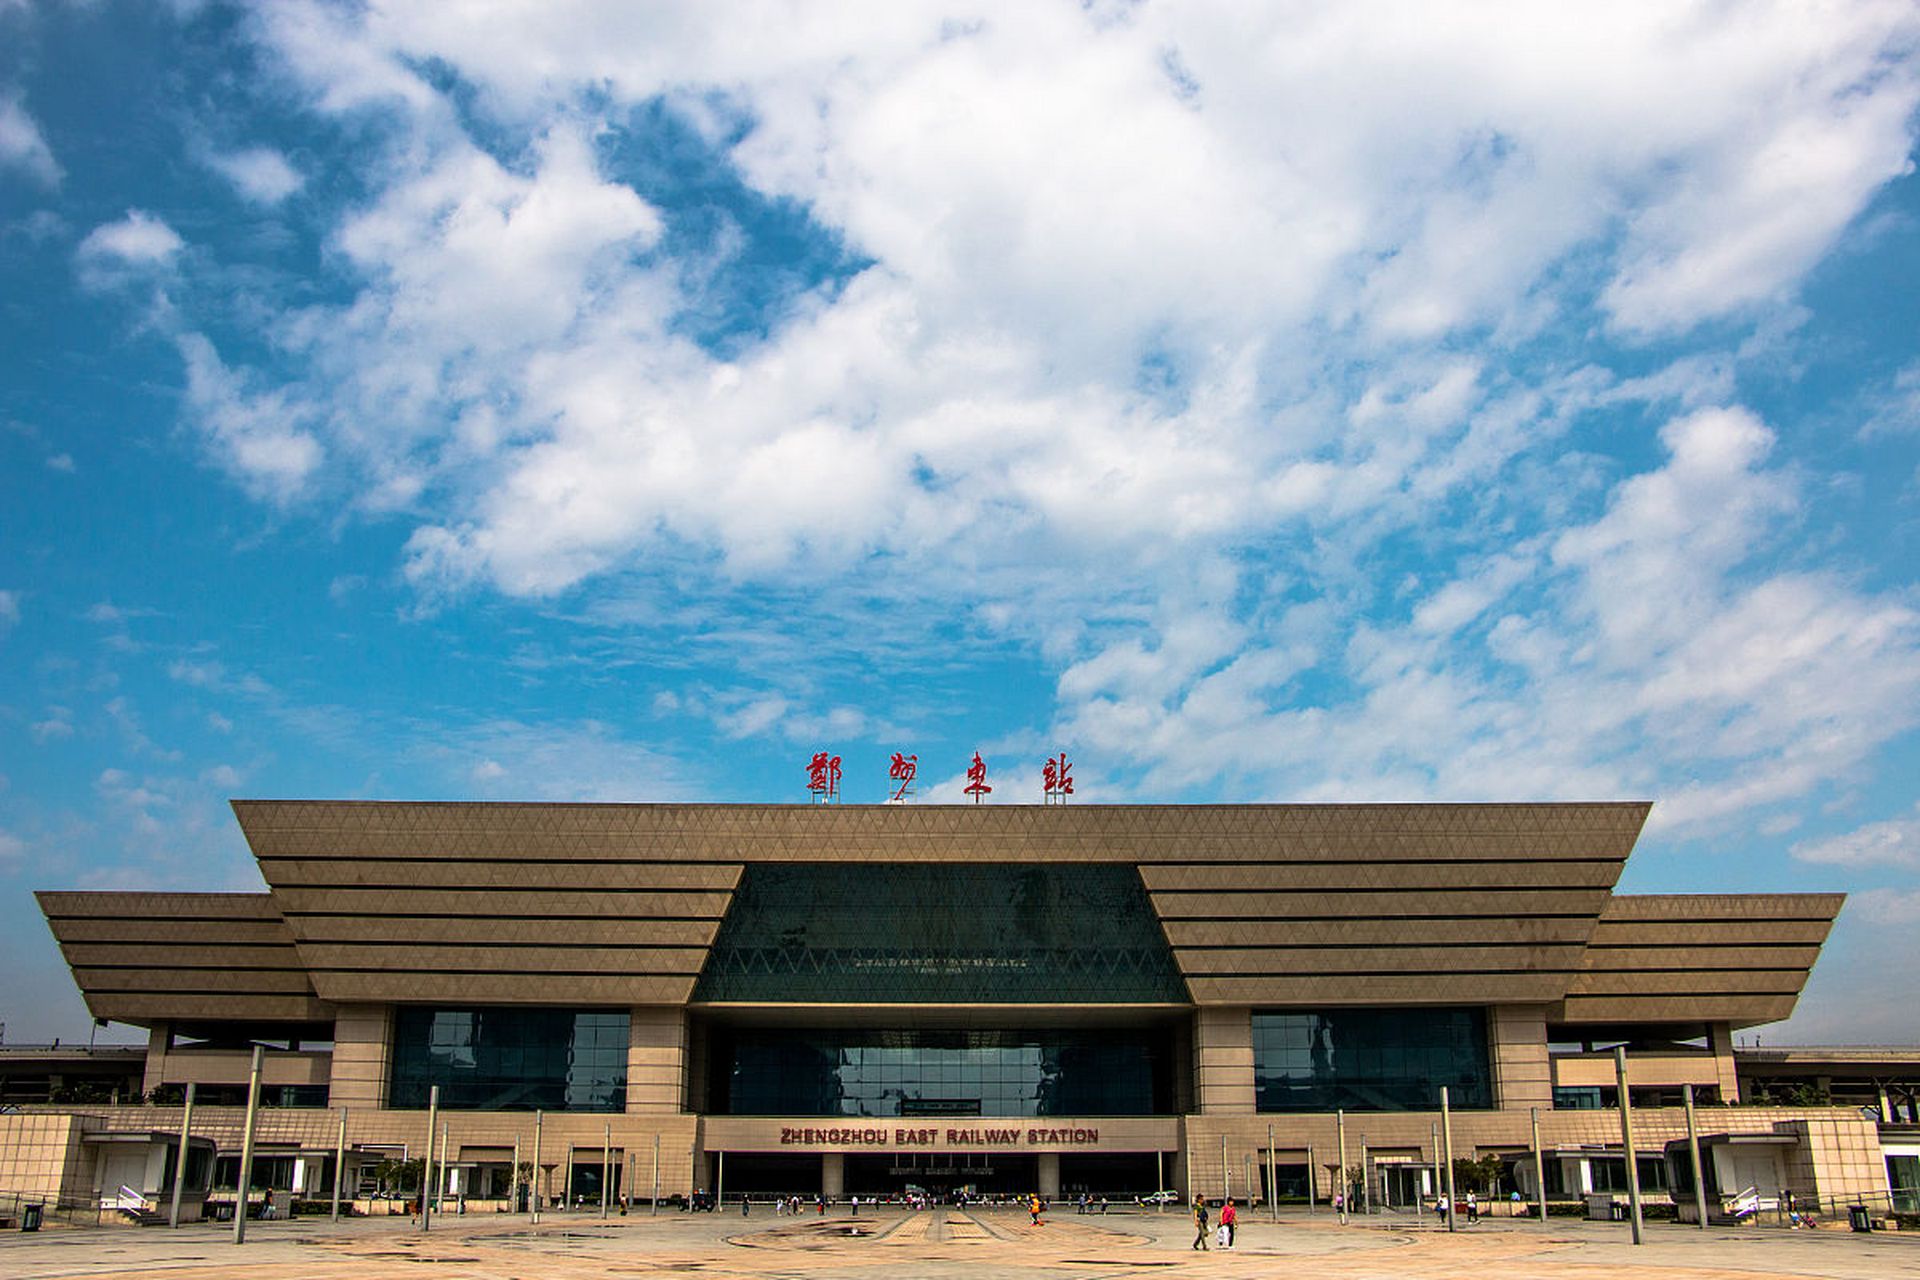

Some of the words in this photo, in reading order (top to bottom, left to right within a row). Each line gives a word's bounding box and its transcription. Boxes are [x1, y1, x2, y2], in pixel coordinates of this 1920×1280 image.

[780, 1128, 887, 1145] ZHENGZHOU
[895, 1128, 938, 1145] EAST
[946, 1128, 1020, 1145] RAILWAY
[1027, 1128, 1099, 1145] STATION
